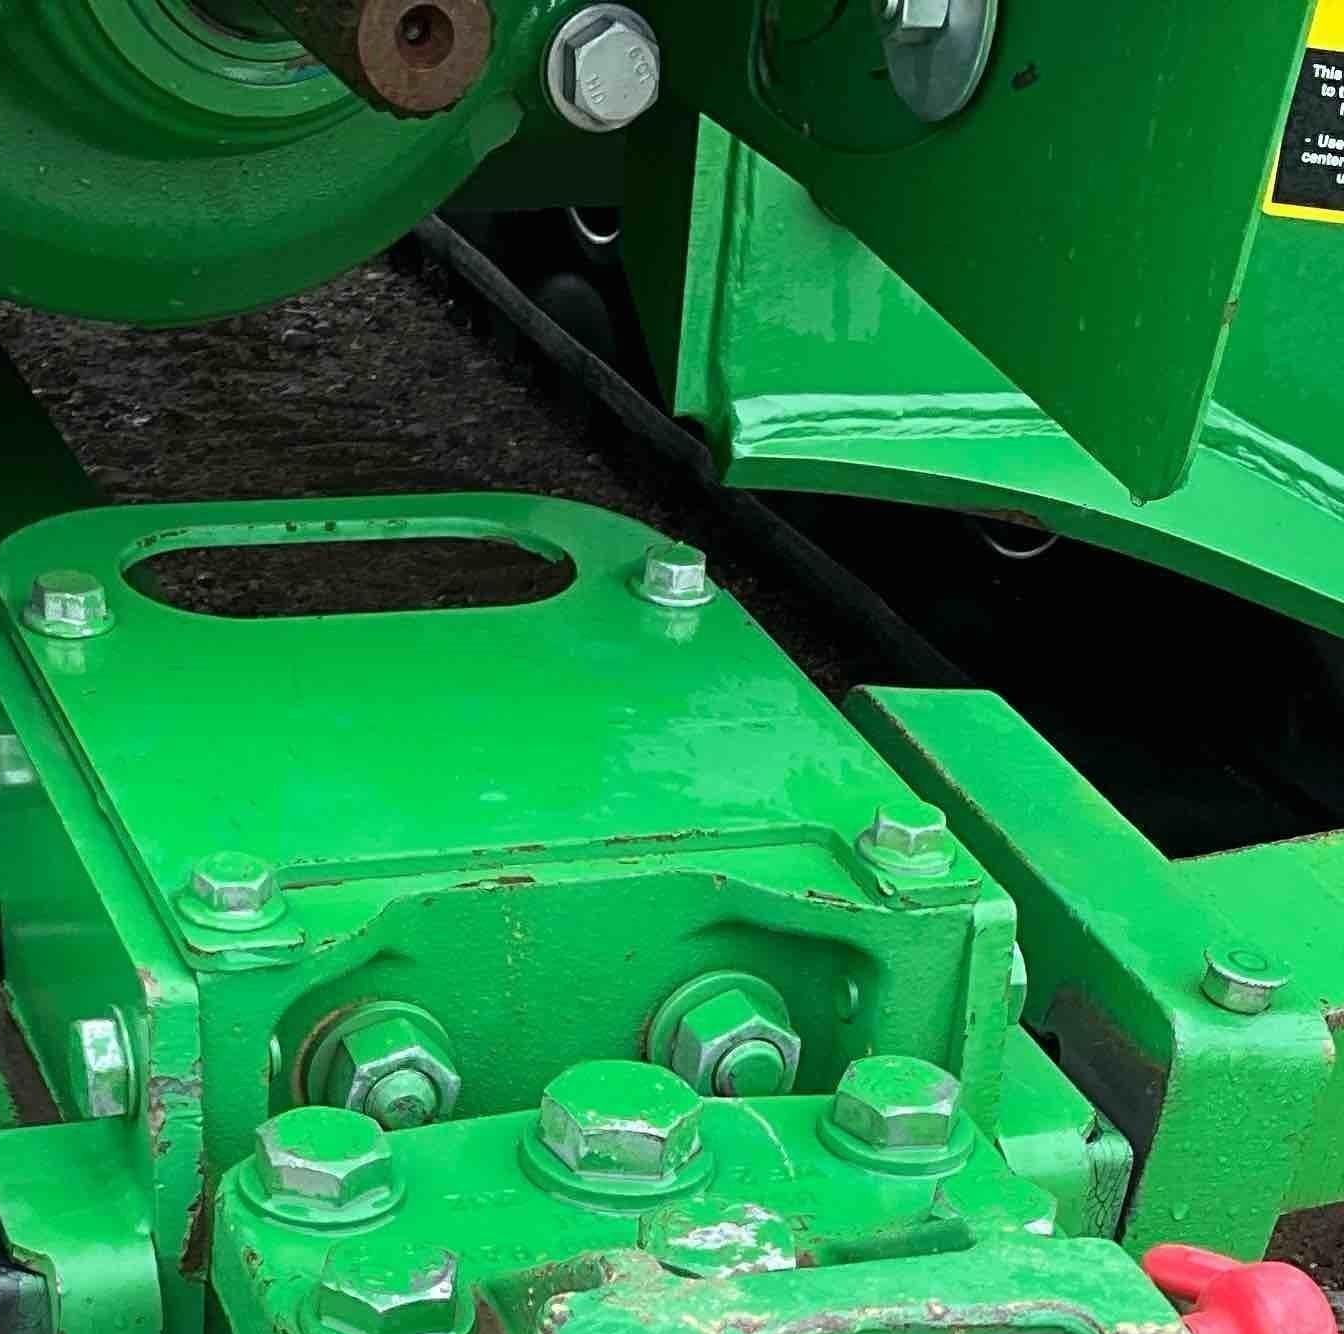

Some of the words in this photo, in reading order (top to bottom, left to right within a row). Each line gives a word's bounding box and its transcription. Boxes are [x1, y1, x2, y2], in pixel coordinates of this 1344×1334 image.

[1313, 63, 1343, 81] This
[1321, 83, 1336, 98] to
[1317, 133, 1344, 151] Use
